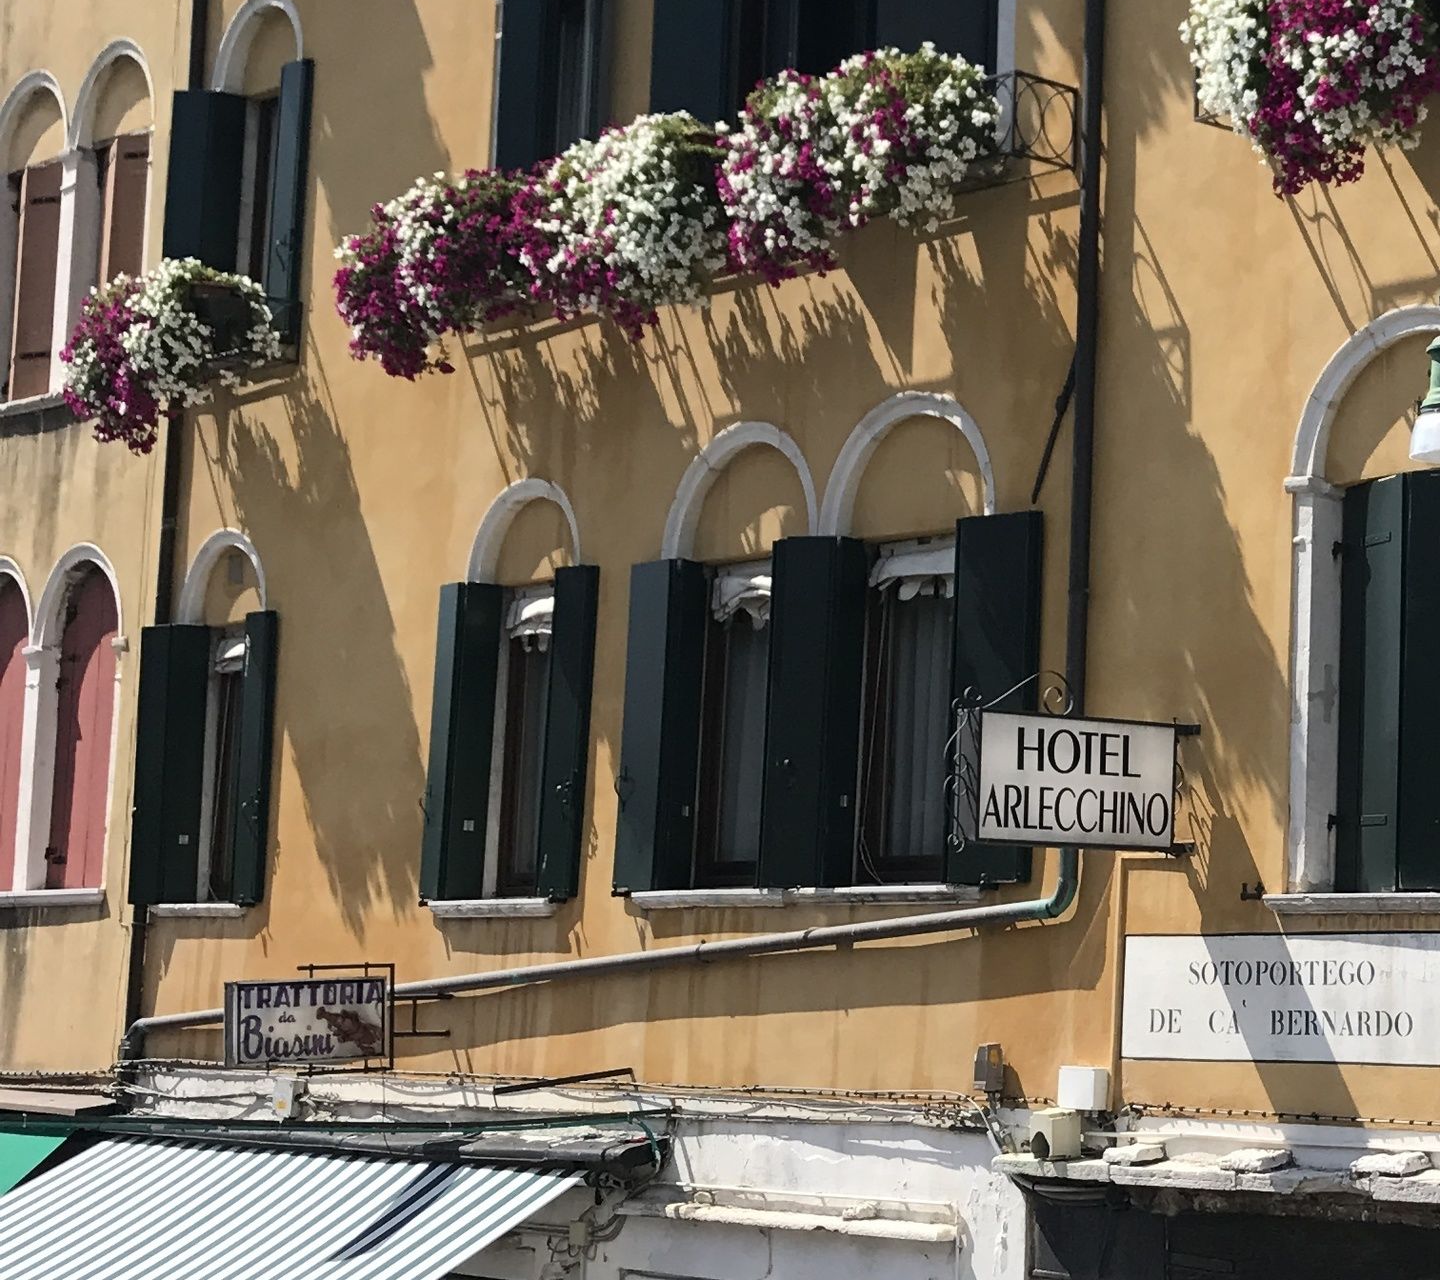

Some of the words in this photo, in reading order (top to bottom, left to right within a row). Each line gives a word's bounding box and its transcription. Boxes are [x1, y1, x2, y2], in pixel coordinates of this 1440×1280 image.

[1017, 726, 1142, 778] HOTEL
[981, 783, 1169, 837] ARLECCHINO
[1188, 960, 1376, 987] SOTOPORTEGO
[240, 981, 383, 1009] TRATTORIA
[278, 1011, 297, 1024] da
[1149, 1008, 1183, 1034] DE
[1269, 1009, 1414, 1038] BERNARDO
[240, 1014, 335, 1060] Biasini
